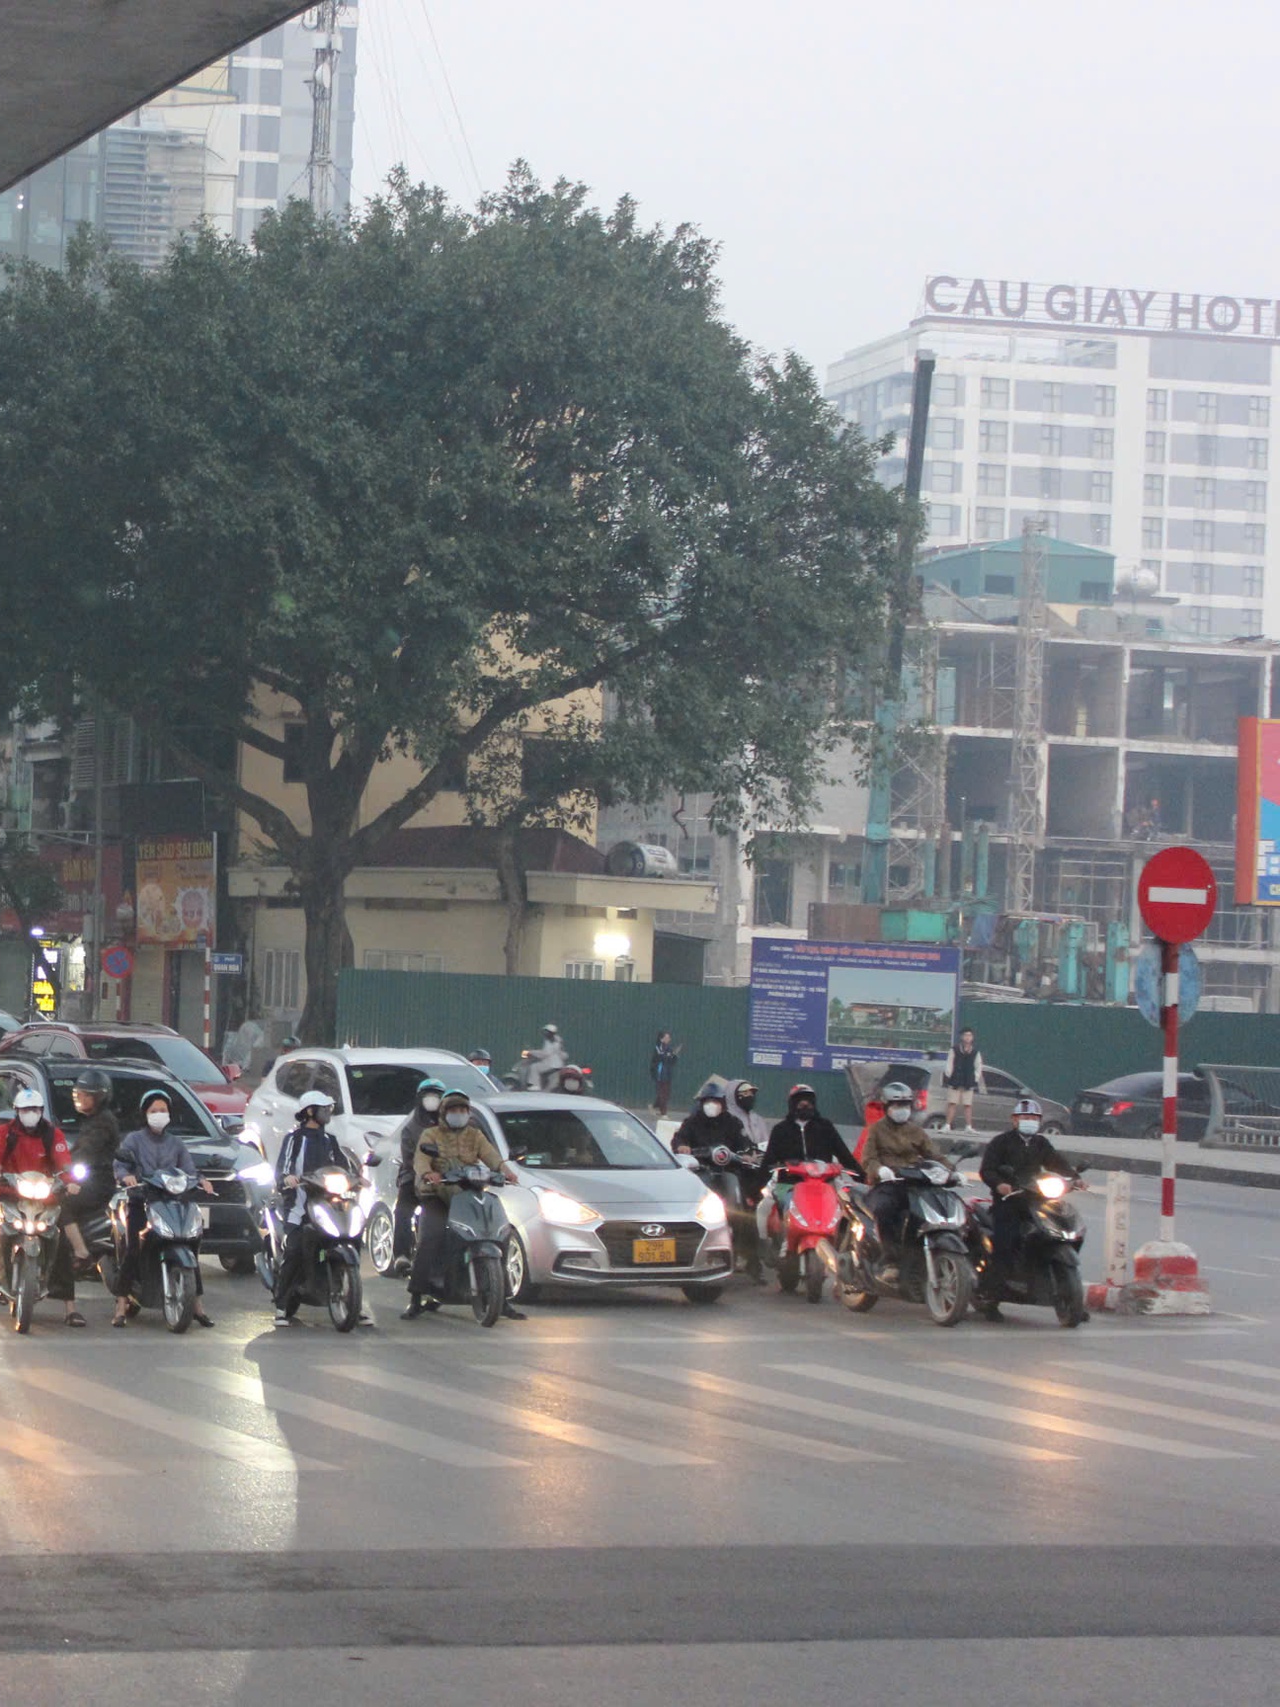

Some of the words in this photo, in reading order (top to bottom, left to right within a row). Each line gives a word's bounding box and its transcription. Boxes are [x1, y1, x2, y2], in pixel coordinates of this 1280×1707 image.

[925, 275, 1029, 317] CAU
[1045, 284, 1156, 326] GIAY
[1170, 292, 1280, 335] HOT
